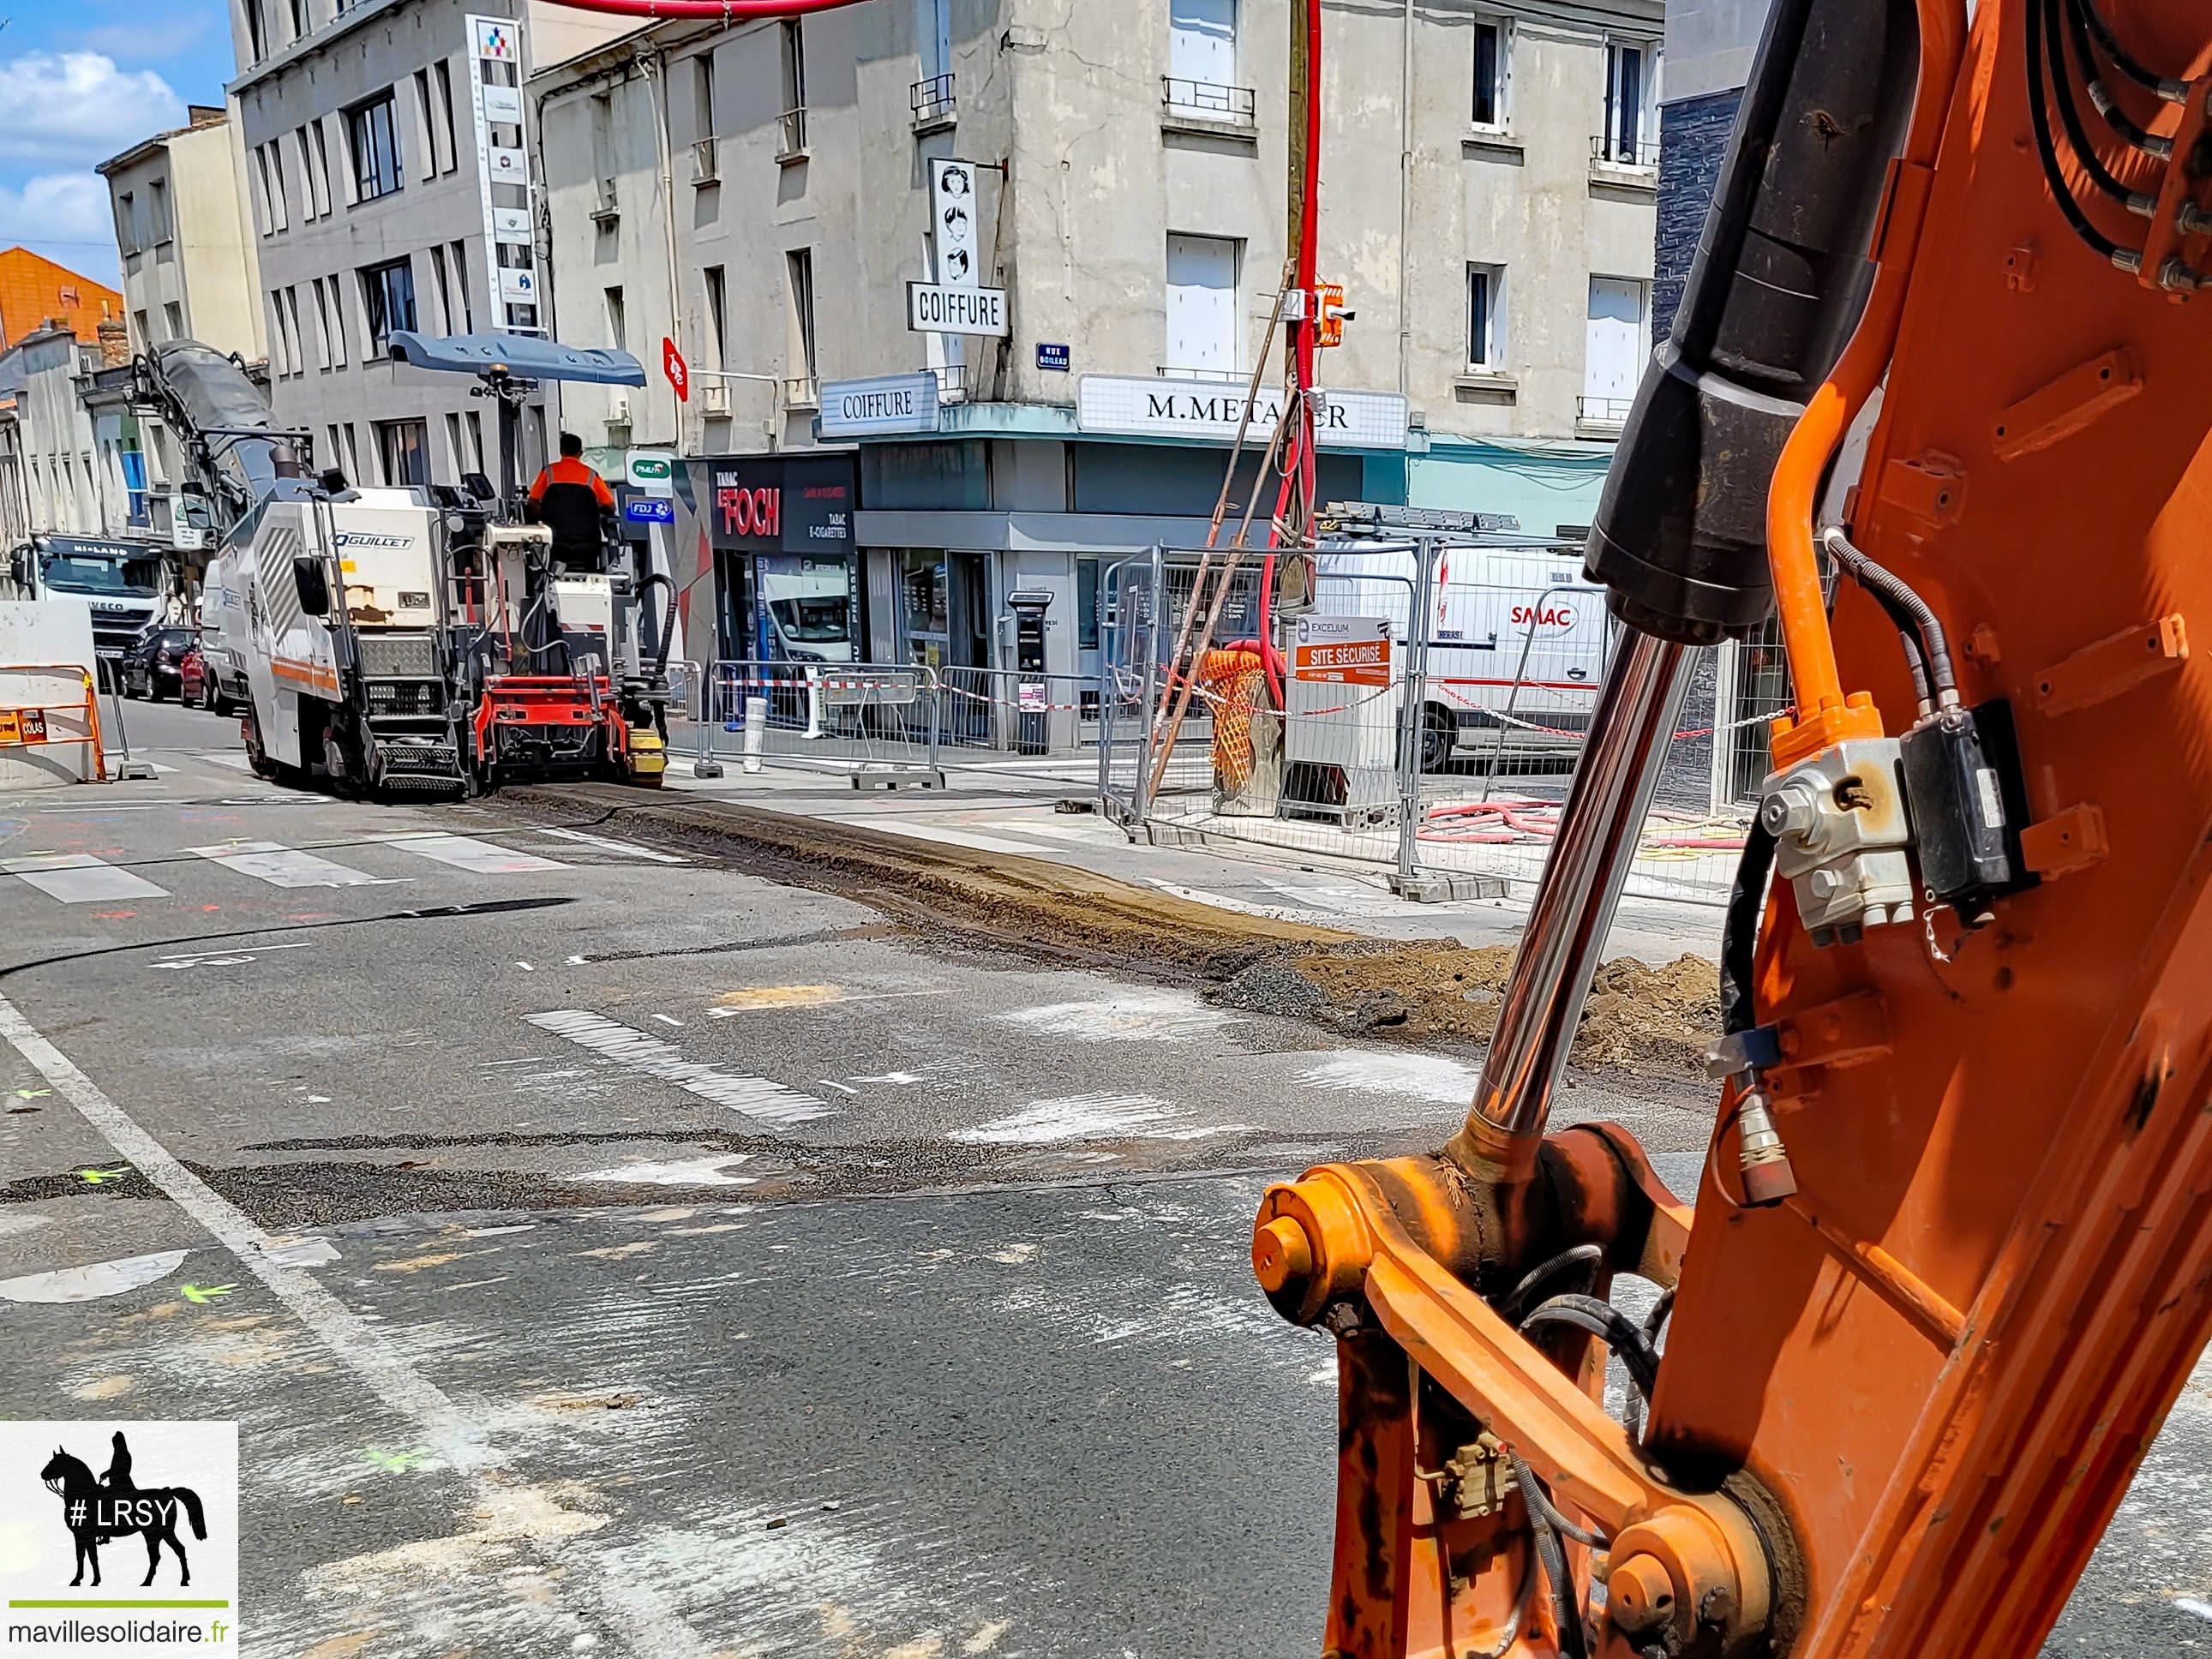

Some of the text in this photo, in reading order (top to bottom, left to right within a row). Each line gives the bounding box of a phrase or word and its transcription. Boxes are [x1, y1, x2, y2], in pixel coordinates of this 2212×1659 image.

[920, 291, 999, 326] COIFFURE
[1046, 346, 1061, 356] RUE
[842, 391, 913, 419] COIFFURE
[1146, 392, 1350, 429] M.METAER
[635, 465, 655, 474] PMU
[716, 471, 738, 488] TABAC
[633, 504, 652, 514] FDJ
[725, 487, 781, 536] FOCH
[829, 513, 846, 525] TABAC
[348, 536, 412, 548] GUILLET
[848, 566, 859, 624] PRESSE
[1511, 607, 1571, 626] SMAC
[1311, 623, 1350, 633] EXCELIUM
[1310, 641, 1381, 666] SITE SÉCURISÉ
[22, 722, 44, 735] COLAS
